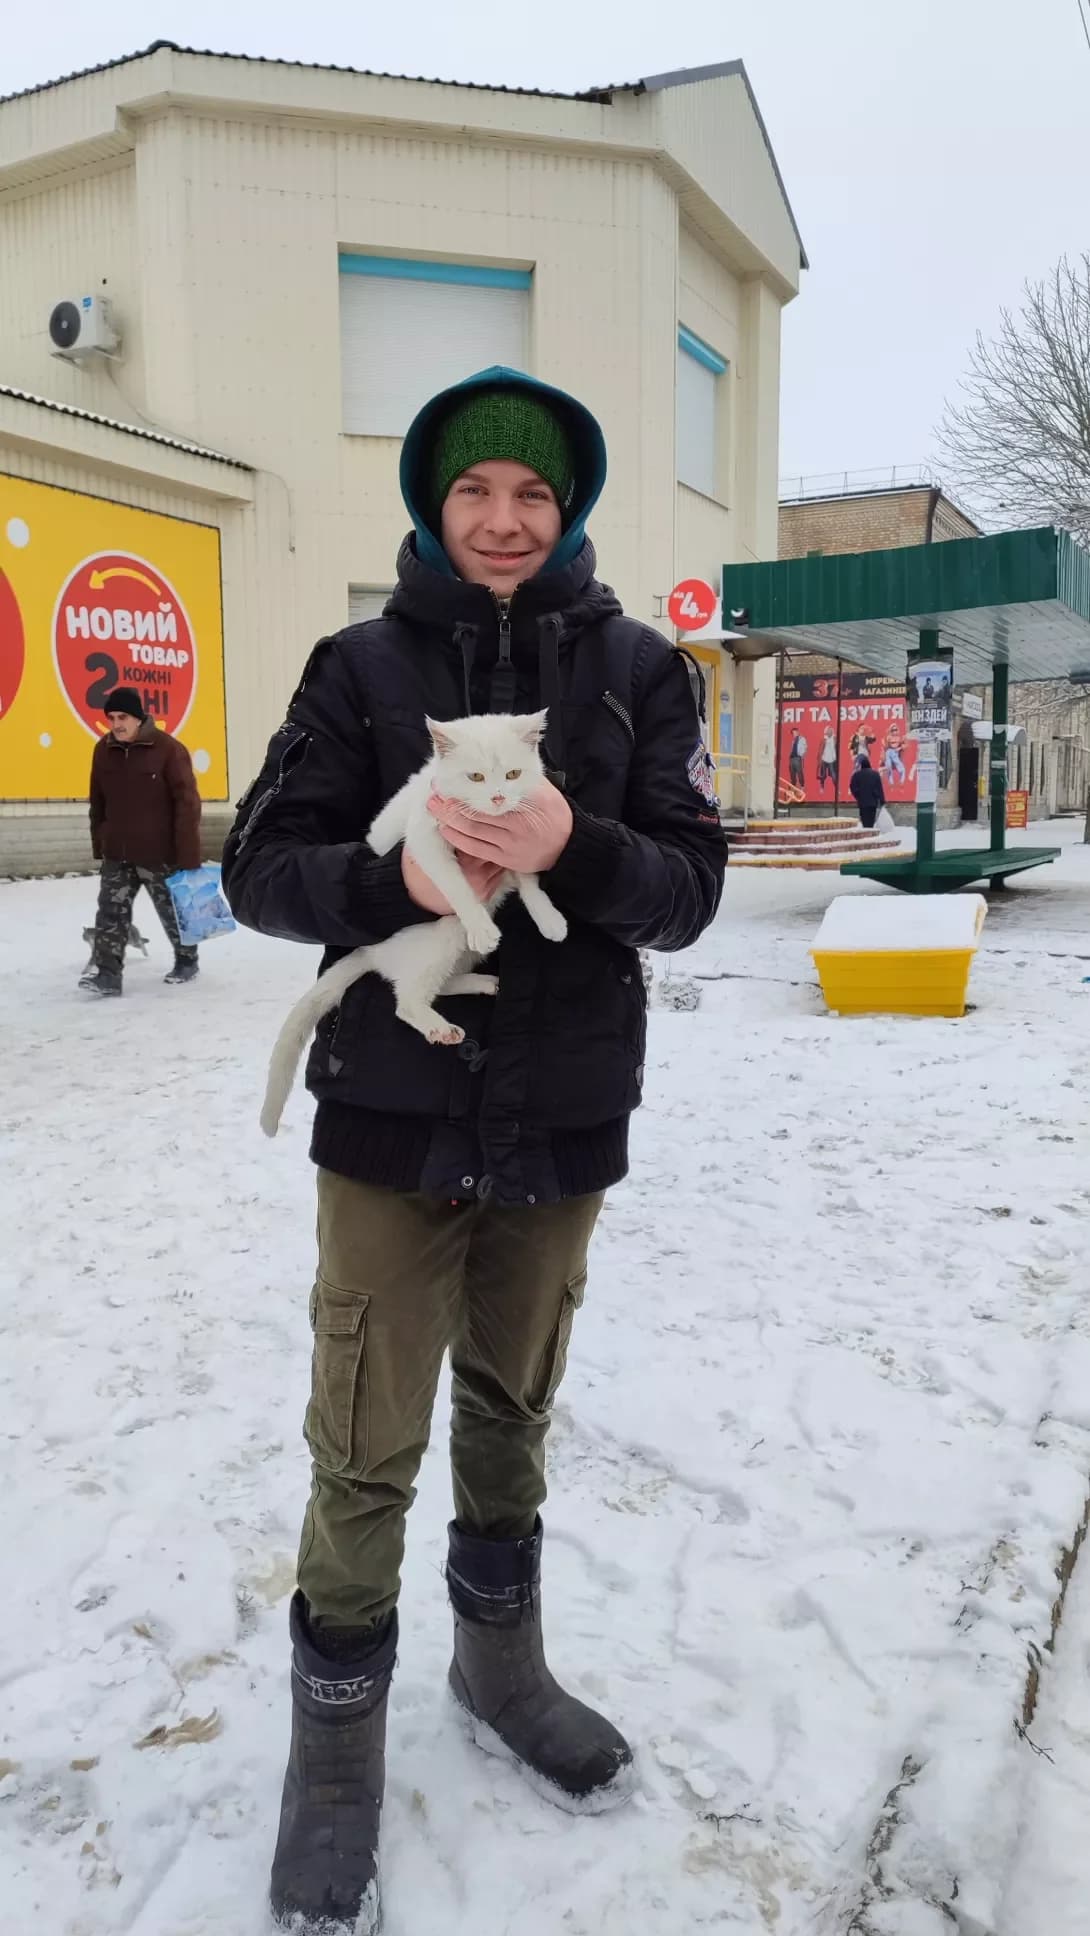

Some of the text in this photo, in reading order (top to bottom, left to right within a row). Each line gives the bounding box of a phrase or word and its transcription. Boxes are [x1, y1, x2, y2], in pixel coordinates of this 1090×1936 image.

[680, 592, 699, 618] 4
[65, 602, 178, 642] НОВИЙ
[128, 643, 189, 668] ТОВАР
[85, 651, 119, 709] 2
[123, 666, 172, 685] КОЖНІ
[864, 677, 905, 686] МЕРЕЖ
[143, 688, 169, 715] НІ
[809, 706, 831, 722] ТА
[840, 704, 904, 722] ВЗУТТЯ
